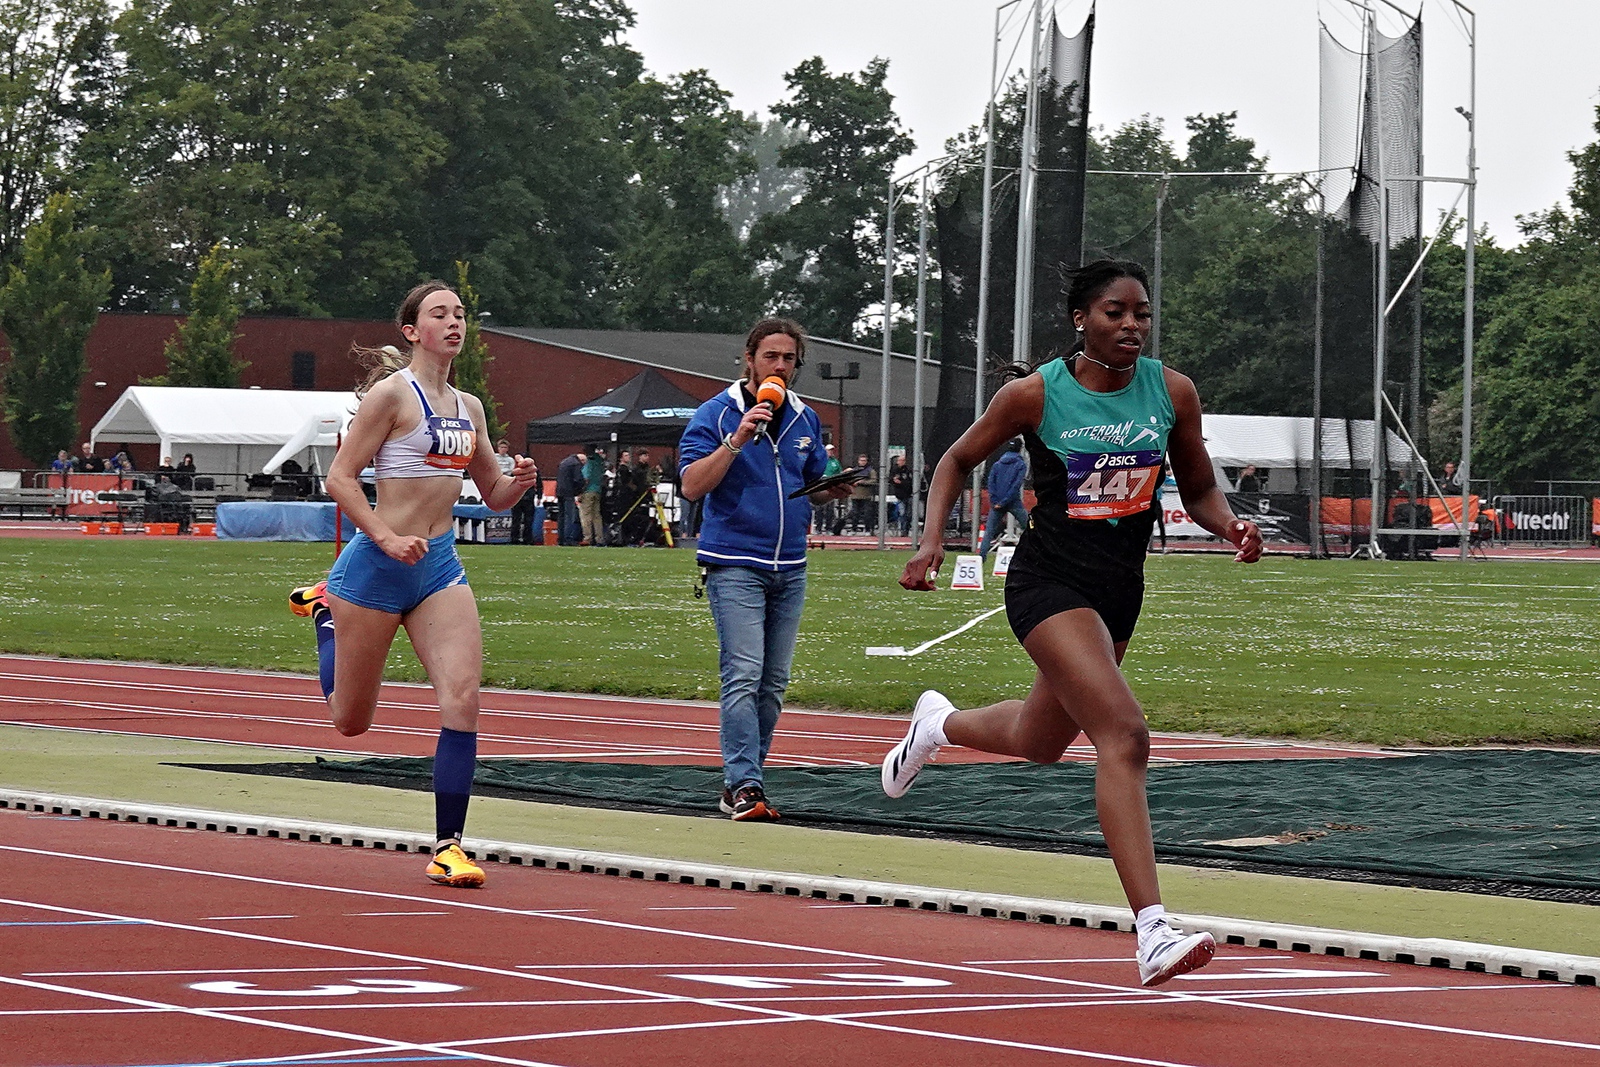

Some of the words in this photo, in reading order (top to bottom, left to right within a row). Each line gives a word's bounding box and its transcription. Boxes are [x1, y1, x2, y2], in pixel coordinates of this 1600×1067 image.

[1060, 419, 1134, 439] ROTTERDAM
[436, 429, 473, 457] 1018
[1077, 469, 1151, 501] 447
[959, 566, 976, 579] 55
[187, 978, 464, 996] 3
